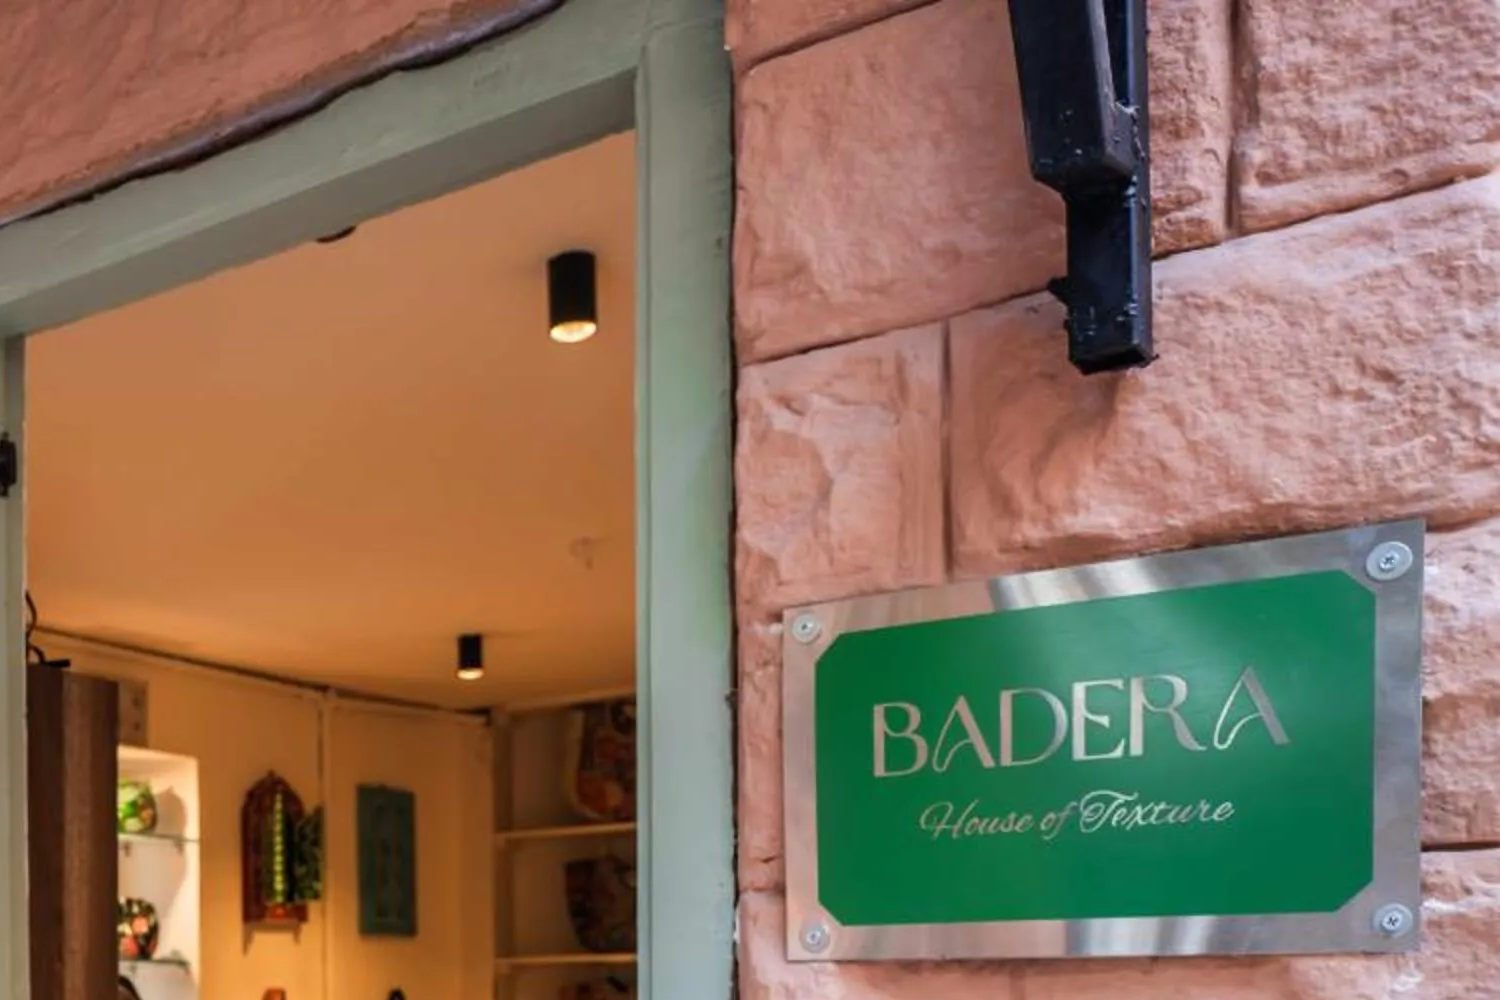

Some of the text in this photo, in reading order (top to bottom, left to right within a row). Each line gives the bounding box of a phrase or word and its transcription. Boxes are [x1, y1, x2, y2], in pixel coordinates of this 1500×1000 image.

[872, 665, 1290, 778] BADERA
[919, 789, 1235, 841] House of Texture
